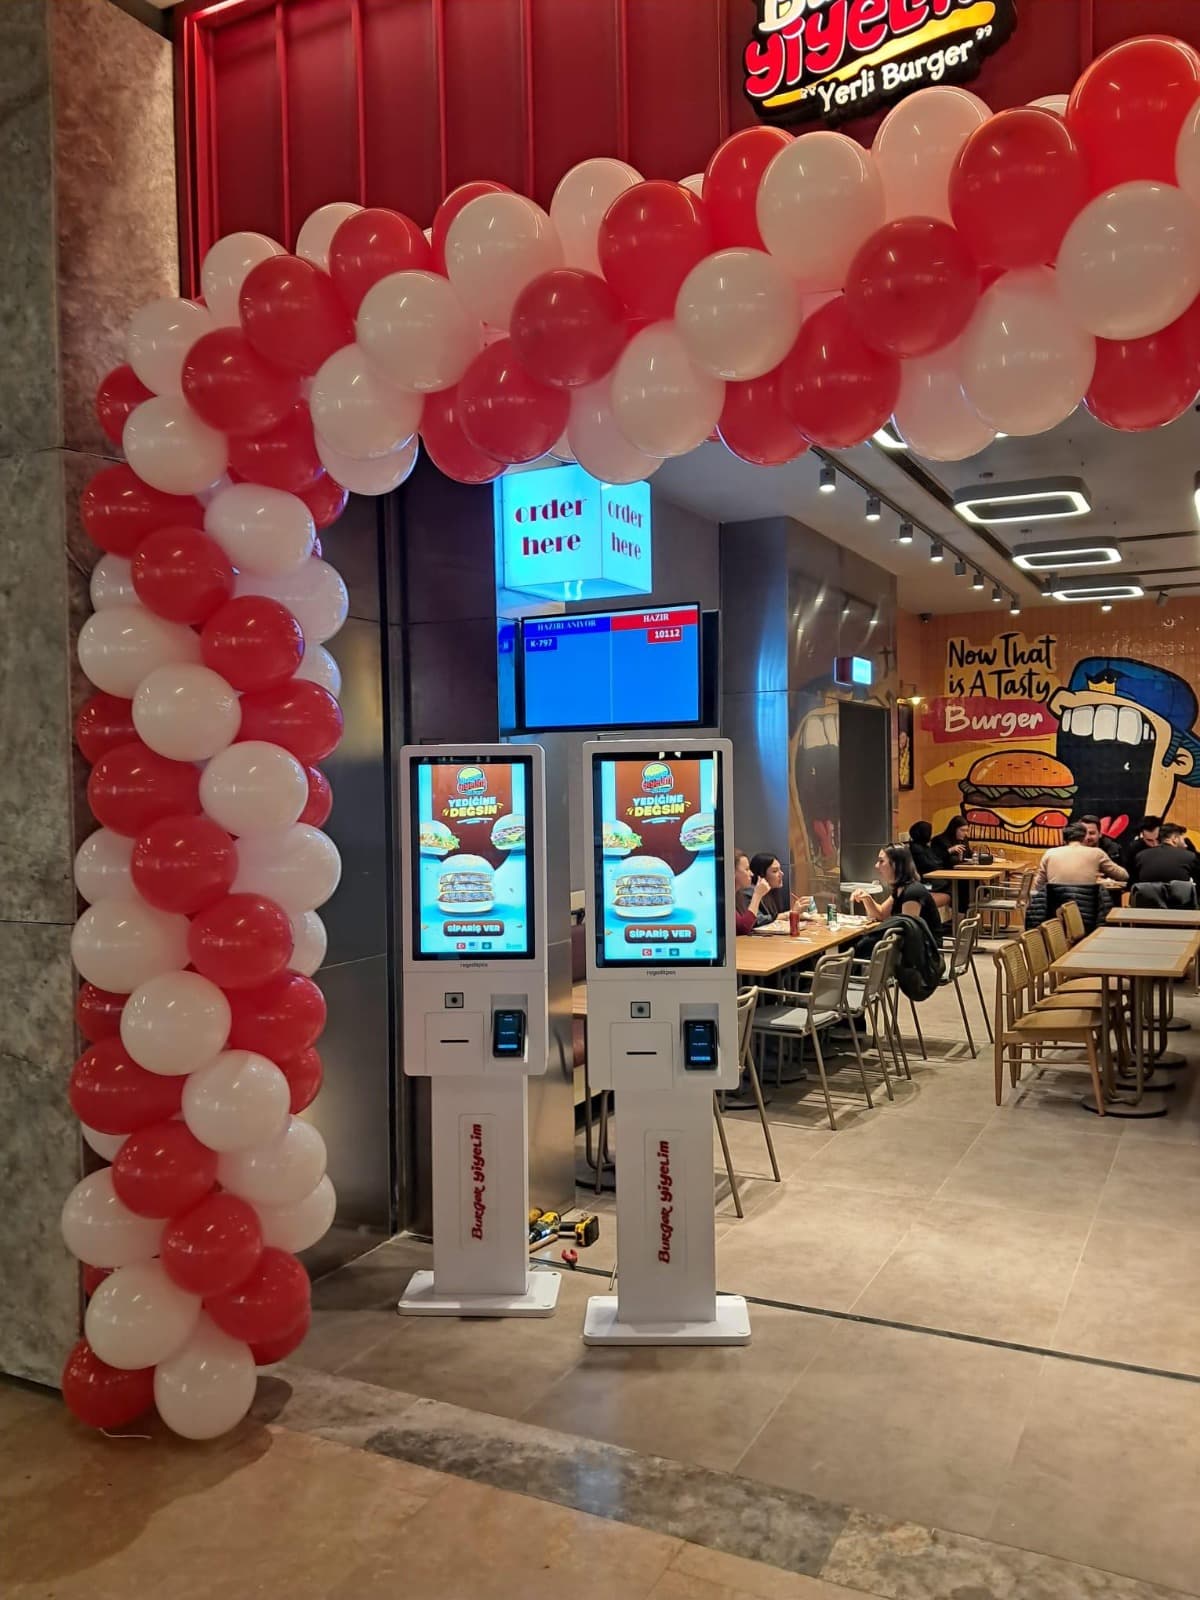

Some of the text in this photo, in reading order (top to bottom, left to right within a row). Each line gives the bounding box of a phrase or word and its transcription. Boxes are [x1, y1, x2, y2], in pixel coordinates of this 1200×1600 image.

[514, 498, 588, 524] order
[607, 499, 643, 529] order
[521, 533, 582, 556] here
[610, 531, 642, 560] here
[642, 613, 670, 623] HAZIR
[530, 638, 553, 648] K-797
[654, 628, 681, 639] 10112
[948, 632, 1057, 670] Now That
[949, 667, 1051, 704] is A Tasty
[944, 704, 1044, 737] Burger
[483, 924, 501, 932] VER
[671, 929, 692, 938] VER
